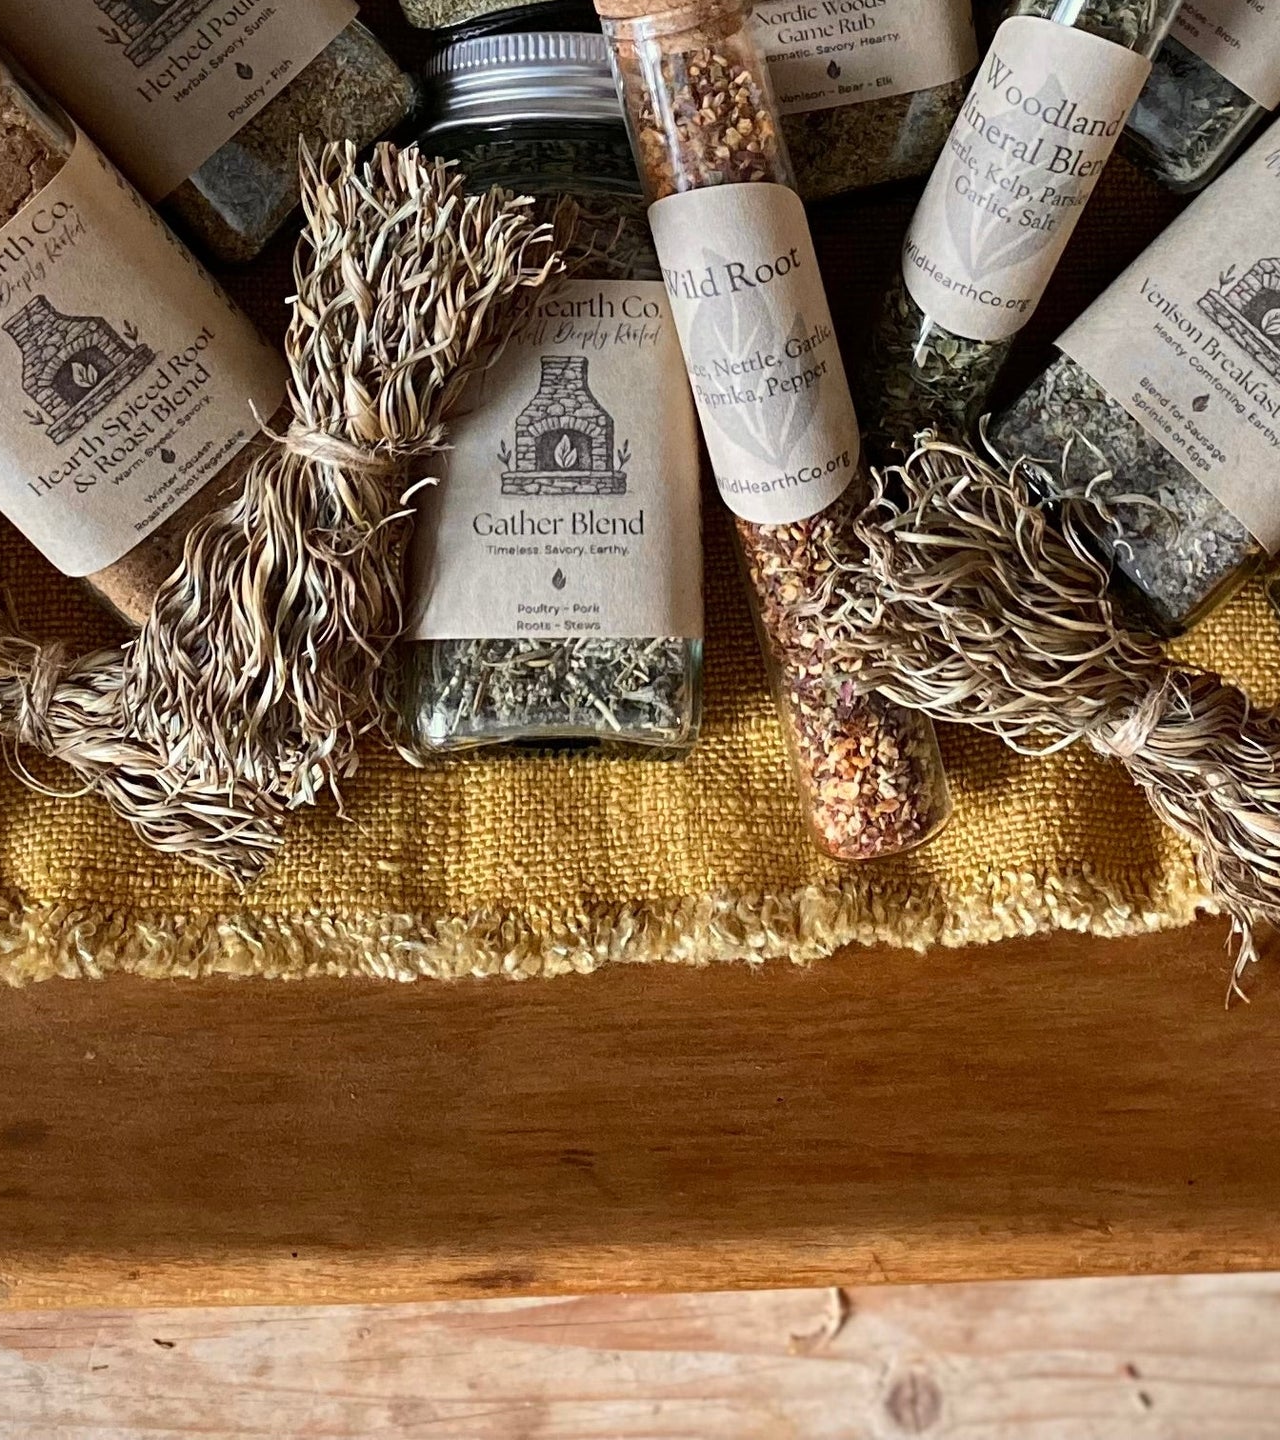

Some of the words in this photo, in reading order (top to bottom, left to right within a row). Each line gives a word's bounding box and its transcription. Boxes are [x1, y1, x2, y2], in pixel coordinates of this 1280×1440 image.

[777, 25, 834, 45] Game
[840, 15, 875, 34] Rub
[1217, 26, 1241, 49] Broth
[137, 29, 210, 104] Herbed
[227, 86, 264, 121] Poultry
[271, 59, 293, 82] Fish
[780, 88, 825, 103] Venison
[876, 76, 892, 86] Elk
[986, 52, 1124, 139] Woodland
[954, 174, 1012, 223] Garlic,
[1019, 209, 1055, 232] Salt
[985, 162, 1033, 204] Kelp,
[31, 201, 73, 236] Co.
[663, 267, 721, 300] Wild
[723, 247, 801, 293] Root
[622, 295, 662, 319] Co.
[1139, 277, 1202, 345] Venison
[712, 354, 783, 378] Nettle,
[766, 359, 827, 398] Pepper
[27, 433, 105, 497] Hearth
[102, 376, 172, 439] Spiced
[168, 325, 216, 377] Root
[74, 473, 97, 494] &
[98, 421, 155, 477] Roast
[153, 367, 212, 422] Blend
[1132, 393, 1172, 434] Sprinkle
[1172, 431, 1187, 447] on
[1185, 444, 1212, 472] Eggs
[1139, 376, 1169, 404] Blend
[1169, 402, 1185, 421] for
[1183, 418, 1226, 462] Sausage
[144, 475, 177, 504] Winter
[179, 441, 214, 474] Squash
[134, 495, 176, 532] Roasted
[176, 467, 198, 495] Root
[473, 511, 563, 537] Gather
[572, 510, 644, 536] Blend
[517, 603, 560, 616] Poultry
[573, 603, 600, 613] Pork
[517, 620, 551, 631] Roots
[565, 620, 601, 631] Stews
